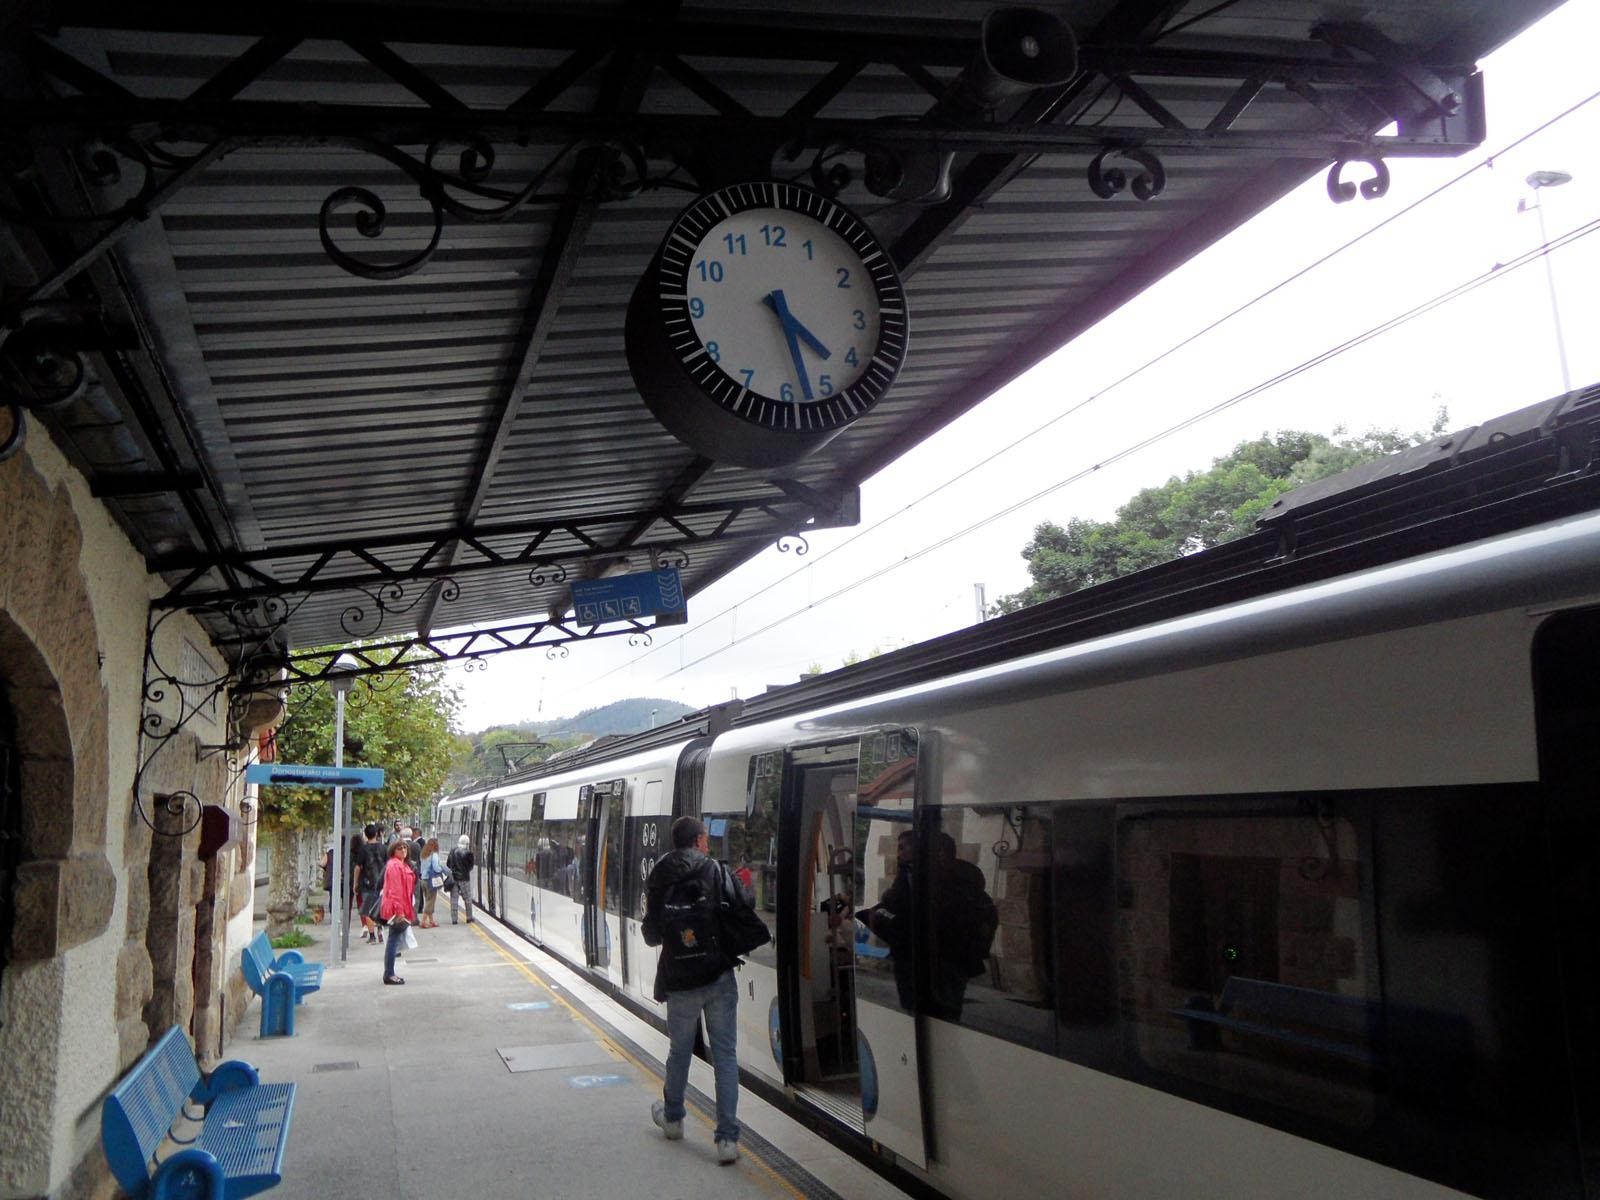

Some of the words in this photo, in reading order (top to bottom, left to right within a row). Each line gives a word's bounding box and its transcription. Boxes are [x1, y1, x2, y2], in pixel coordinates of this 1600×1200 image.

[723, 232, 747, 255] 11
[760, 224, 787, 248] 12
[802, 239, 813, 260] 1
[696, 259, 724, 283] 10
[836, 267, 851, 288] 2
[689, 297, 705, 319] 9
[852, 309, 866, 330] 3
[706, 341, 721, 364] 8
[844, 346, 858, 368] 4
[740, 368, 754, 389] 7
[819, 374, 833, 396] 5
[780, 382, 794, 402] 6
